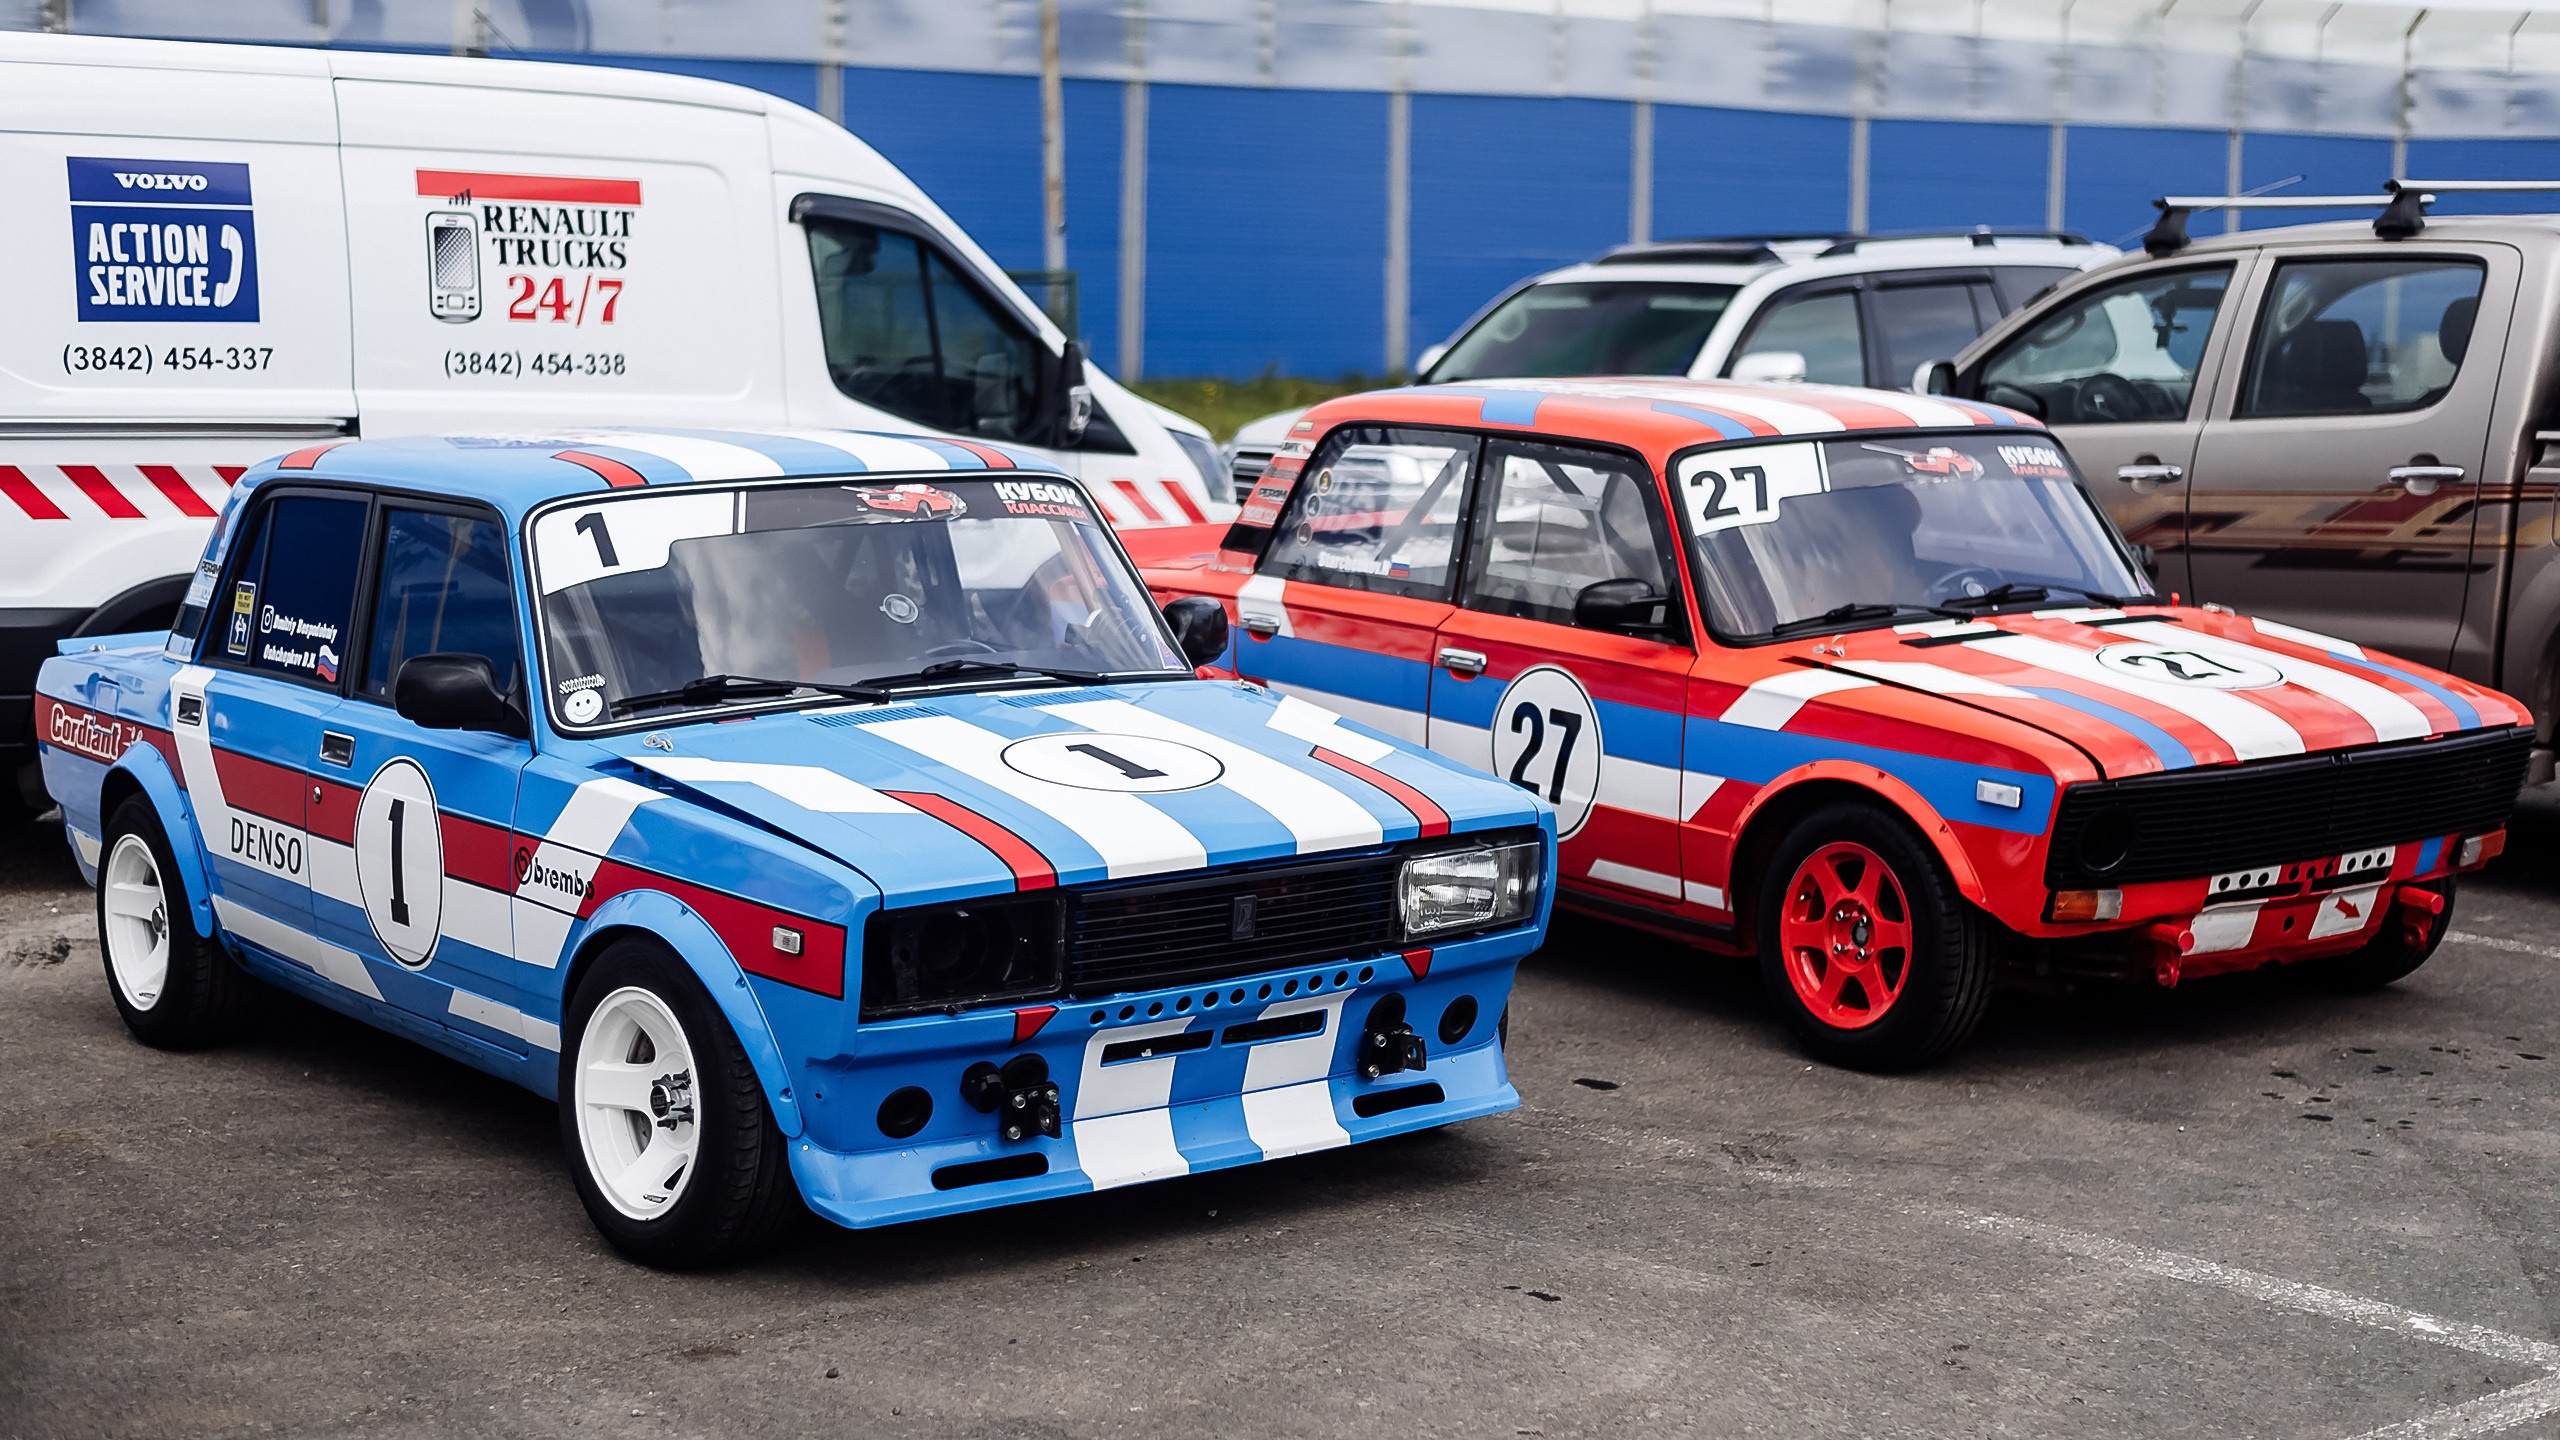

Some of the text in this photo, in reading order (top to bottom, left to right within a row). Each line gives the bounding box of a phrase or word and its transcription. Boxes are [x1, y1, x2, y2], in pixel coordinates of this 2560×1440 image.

[113, 173, 208, 191] VOLVO
[483, 205, 635, 237] RENAULT
[88, 222, 209, 264] ACTION
[492, 237, 627, 269] TRUCKS
[89, 265, 211, 307] SERVICE
[507, 273, 625, 328] 24/7
[63, 344, 274, 375] (3842) 454-337
[444, 350, 626, 379] (3842) 454-338
[1997, 445, 2064, 468] КУБОК
[993, 482, 1083, 507] КУБОК
[1005, 502, 1089, 519] КЛАССИКИ
[1690, 465, 1768, 521] 27
[575, 512, 620, 567] 1
[2120, 651, 2245, 681] 27
[51, 703, 121, 760] Cordiant
[1065, 744, 1169, 779] 1
[1509, 702, 1582, 805] 27
[231, 817, 302, 874] DENSO
[388, 798, 410, 927] 1
[534, 857, 595, 900] brembo
